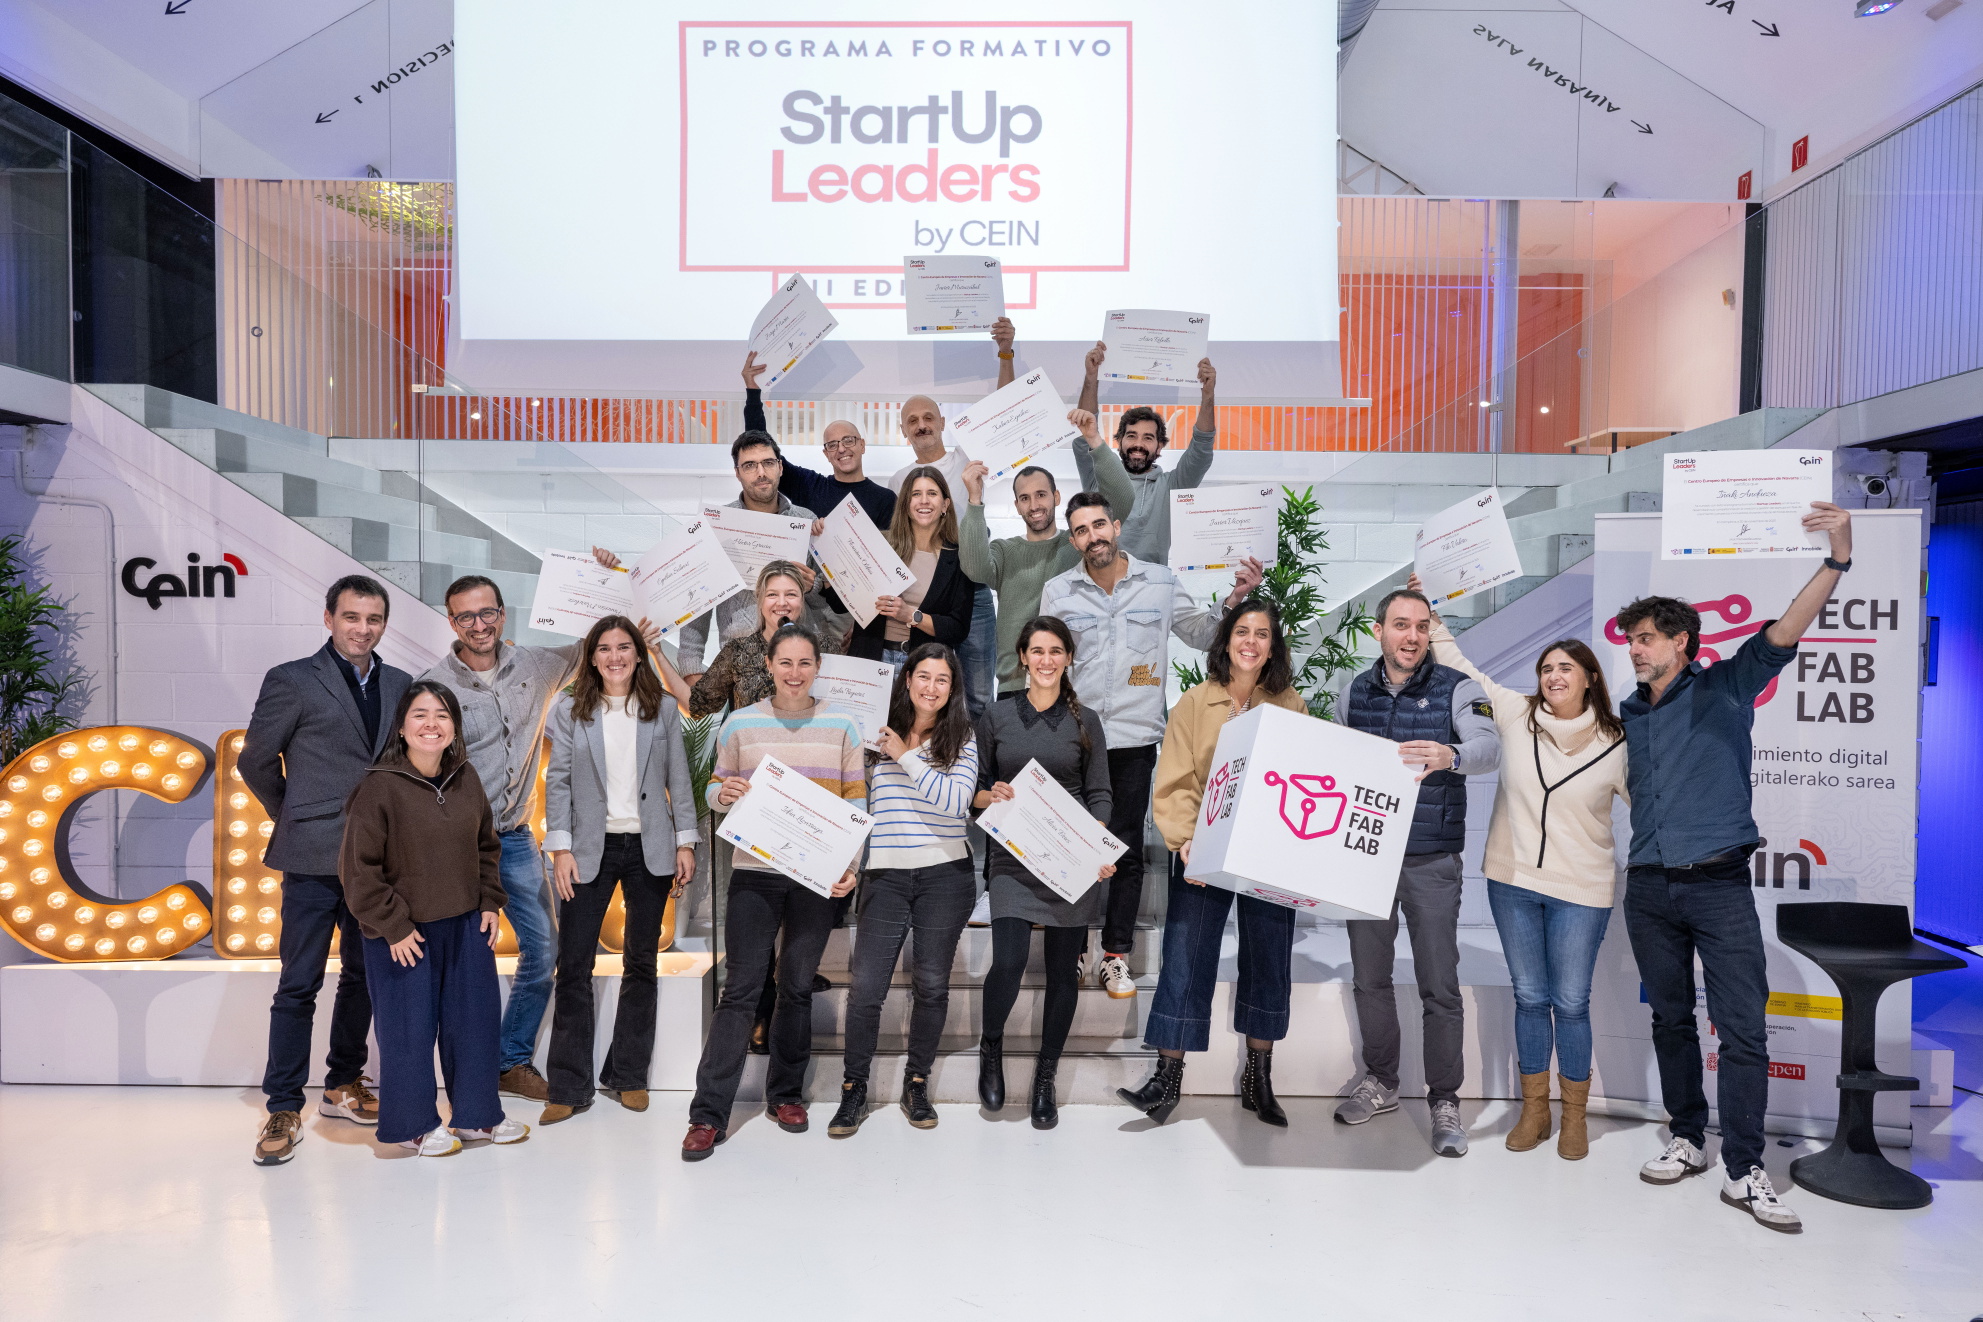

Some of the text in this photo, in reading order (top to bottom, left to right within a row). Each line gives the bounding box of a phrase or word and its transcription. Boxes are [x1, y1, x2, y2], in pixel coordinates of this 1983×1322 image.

[703, 39, 1112, 58] PROGRAMA FORMATIVO
[780, 89, 1043, 158] StartUp
[771, 148, 1041, 203] Leaders
[914, 219, 1039, 253] by CEIN
[1792, 599, 1898, 630] ECH
[1797, 652, 1876, 684] FAB
[1796, 691, 1875, 724] LAB
[1754, 746, 1888, 769] imiento digital
[1750, 769, 1895, 790] gitalerako sarea
[1354, 785, 1400, 814] TECH
[1348, 811, 1384, 836] FAB
[1343, 831, 1380, 856] LAB
